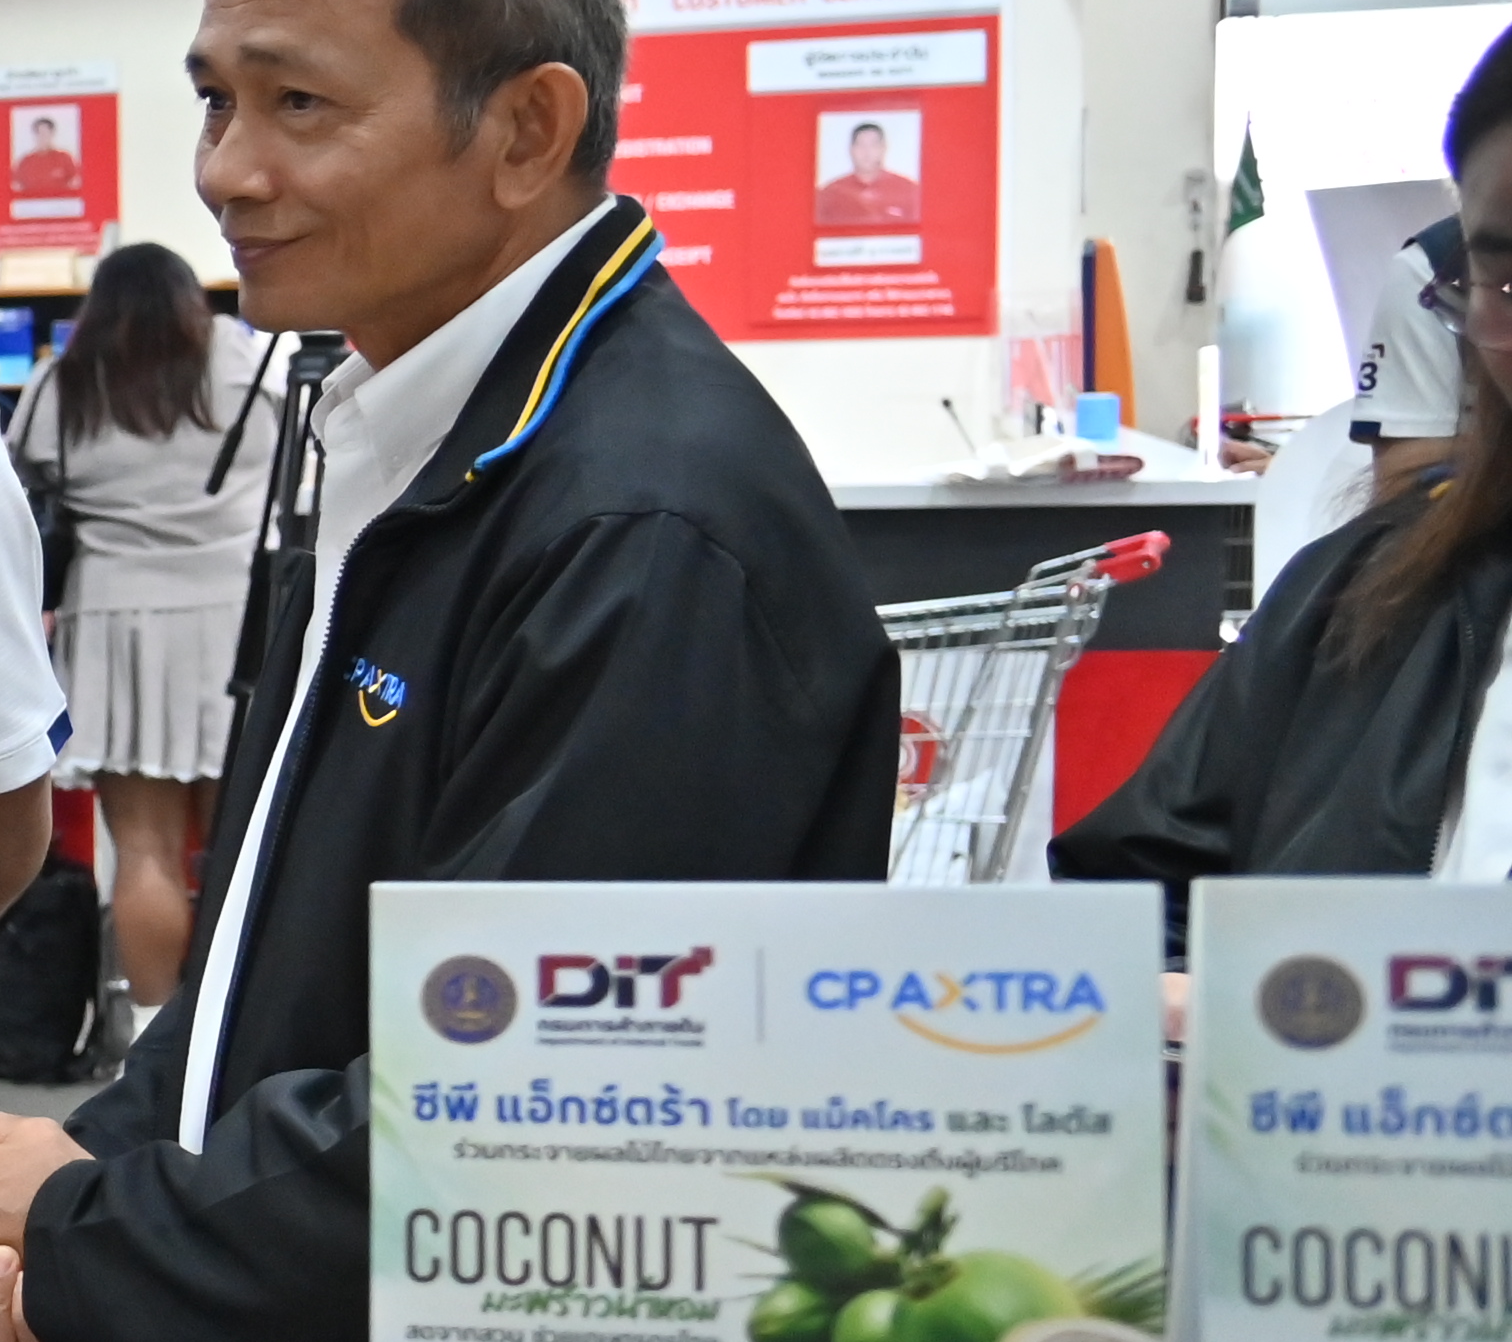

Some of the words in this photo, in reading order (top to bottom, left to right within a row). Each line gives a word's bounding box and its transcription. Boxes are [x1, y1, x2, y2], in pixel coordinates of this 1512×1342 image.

[1357, 361, 1378, 392] 3
[344, 656, 366, 682] P
[806, 970, 883, 1011] CP
[889, 970, 1107, 1013] AXTRA
[1387, 953, 1512, 1013] Di
[412, 1079, 479, 1123] ซีพี
[495, 1077, 712, 1128] แอ็กซ์ตร้า
[726, 1096, 789, 1130] โดย
[800, 1095, 935, 1133] แม็คโคร
[945, 1109, 1011, 1135] และ
[1022, 1101, 1115, 1137] โลตัส
[404, 1206, 720, 1293] COCONUT
[1240, 1224, 1512, 1313] COCON
